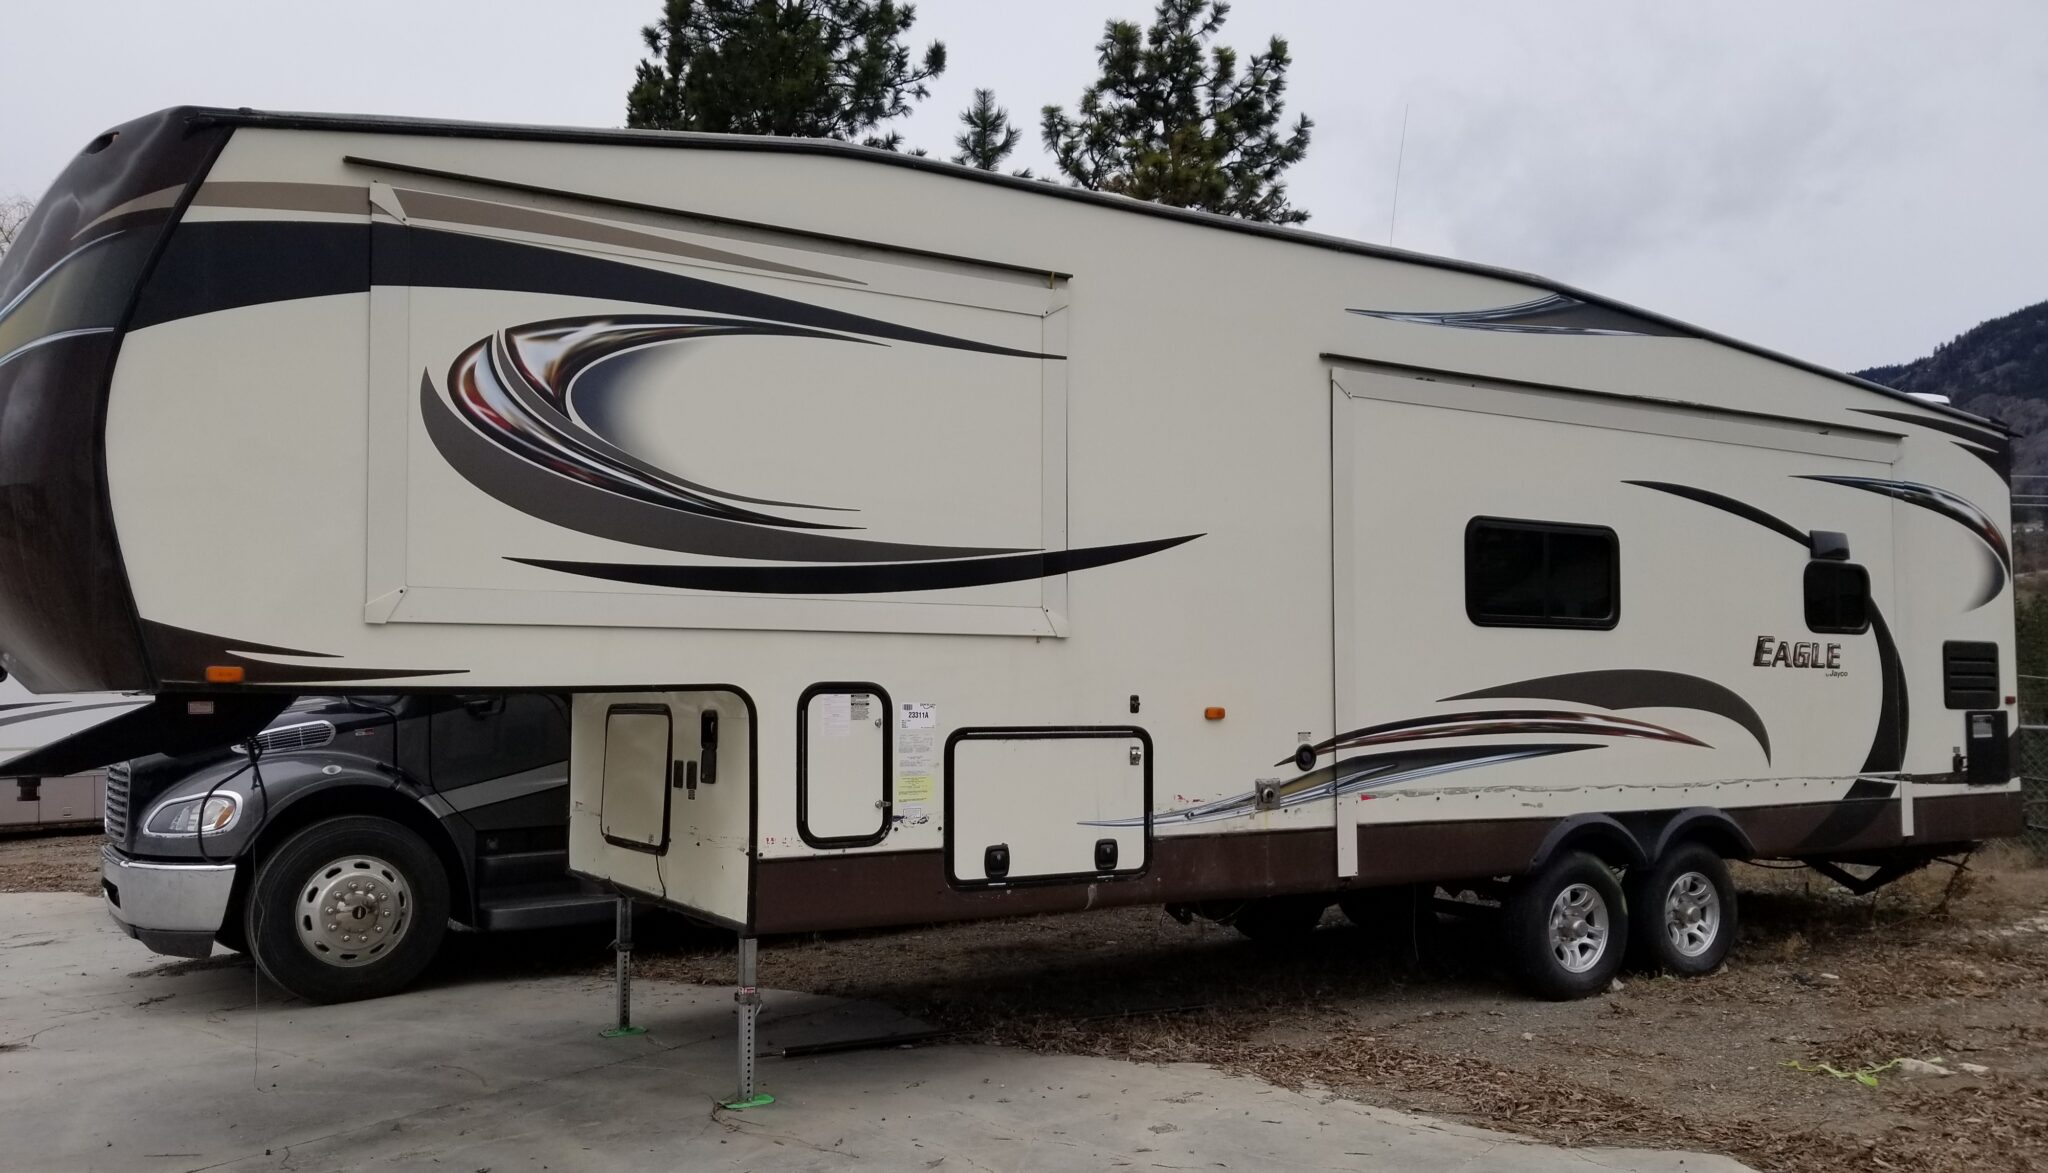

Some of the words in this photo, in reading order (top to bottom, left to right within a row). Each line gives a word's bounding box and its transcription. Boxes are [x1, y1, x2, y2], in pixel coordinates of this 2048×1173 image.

[1753, 635, 1841, 669] EAGLE
[1830, 669, 1848, 678] Jayco
[908, 711, 929, 719] 23311A
